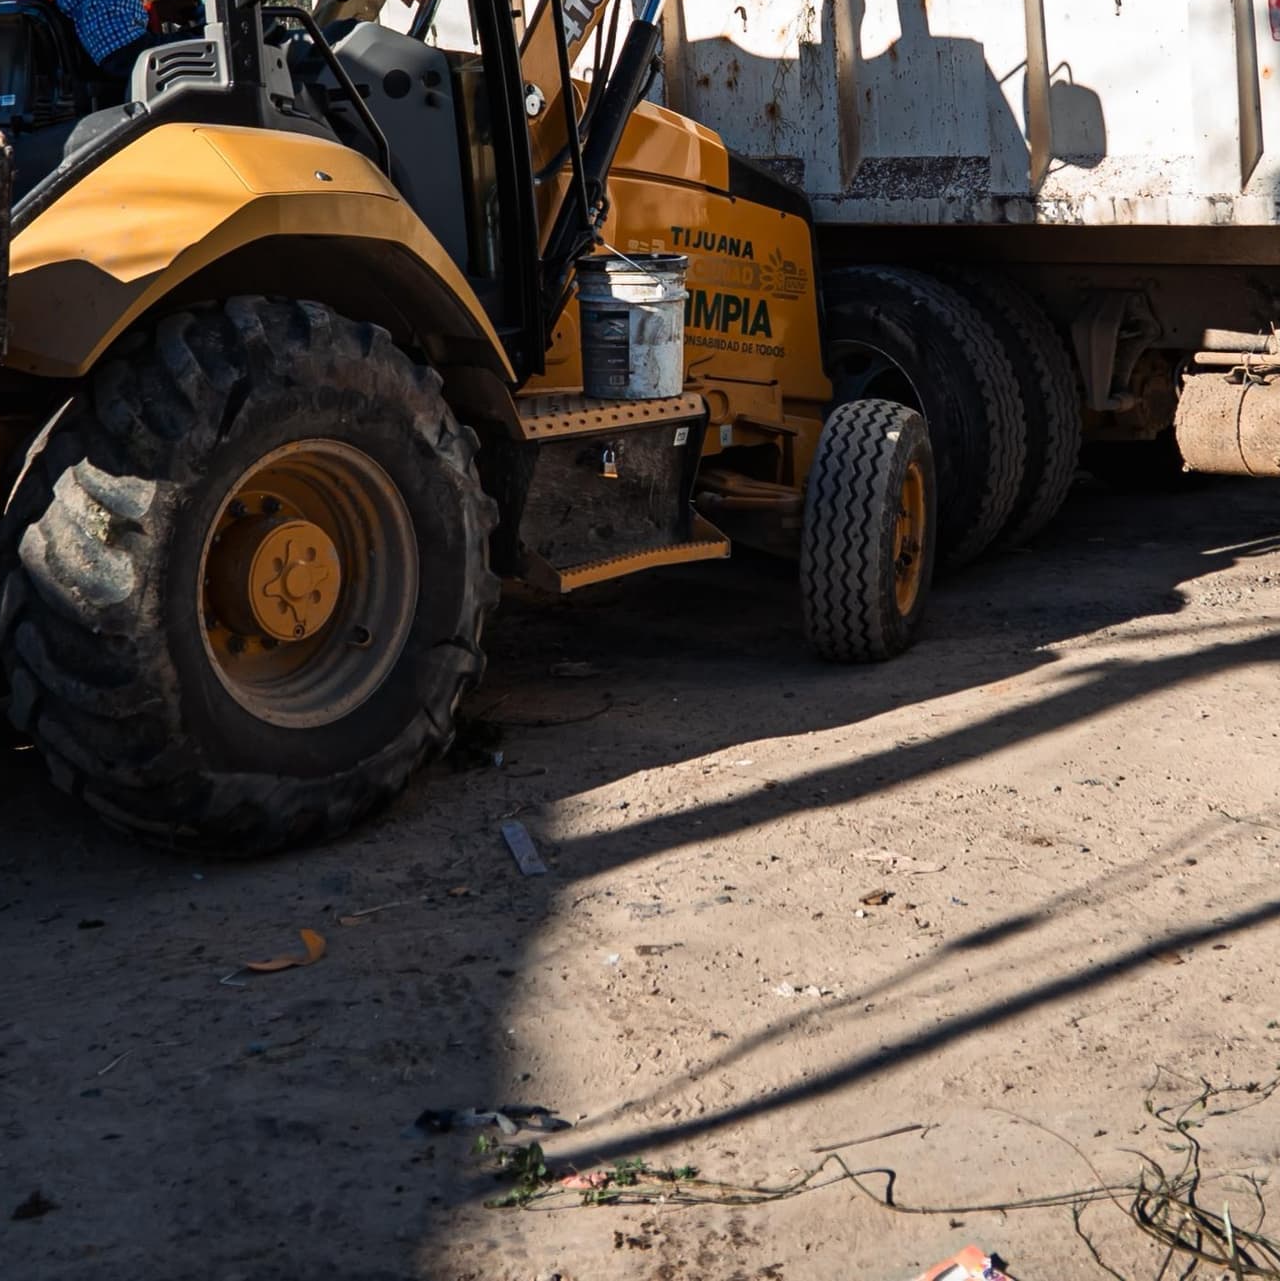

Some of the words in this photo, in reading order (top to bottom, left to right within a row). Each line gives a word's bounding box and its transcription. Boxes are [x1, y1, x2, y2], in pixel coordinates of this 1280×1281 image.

[671, 226, 754, 260] TIJUANA
[683, 288, 773, 338] IMPIA
[742, 342, 753, 354] DE
[756, 343, 785, 358] TODOS
